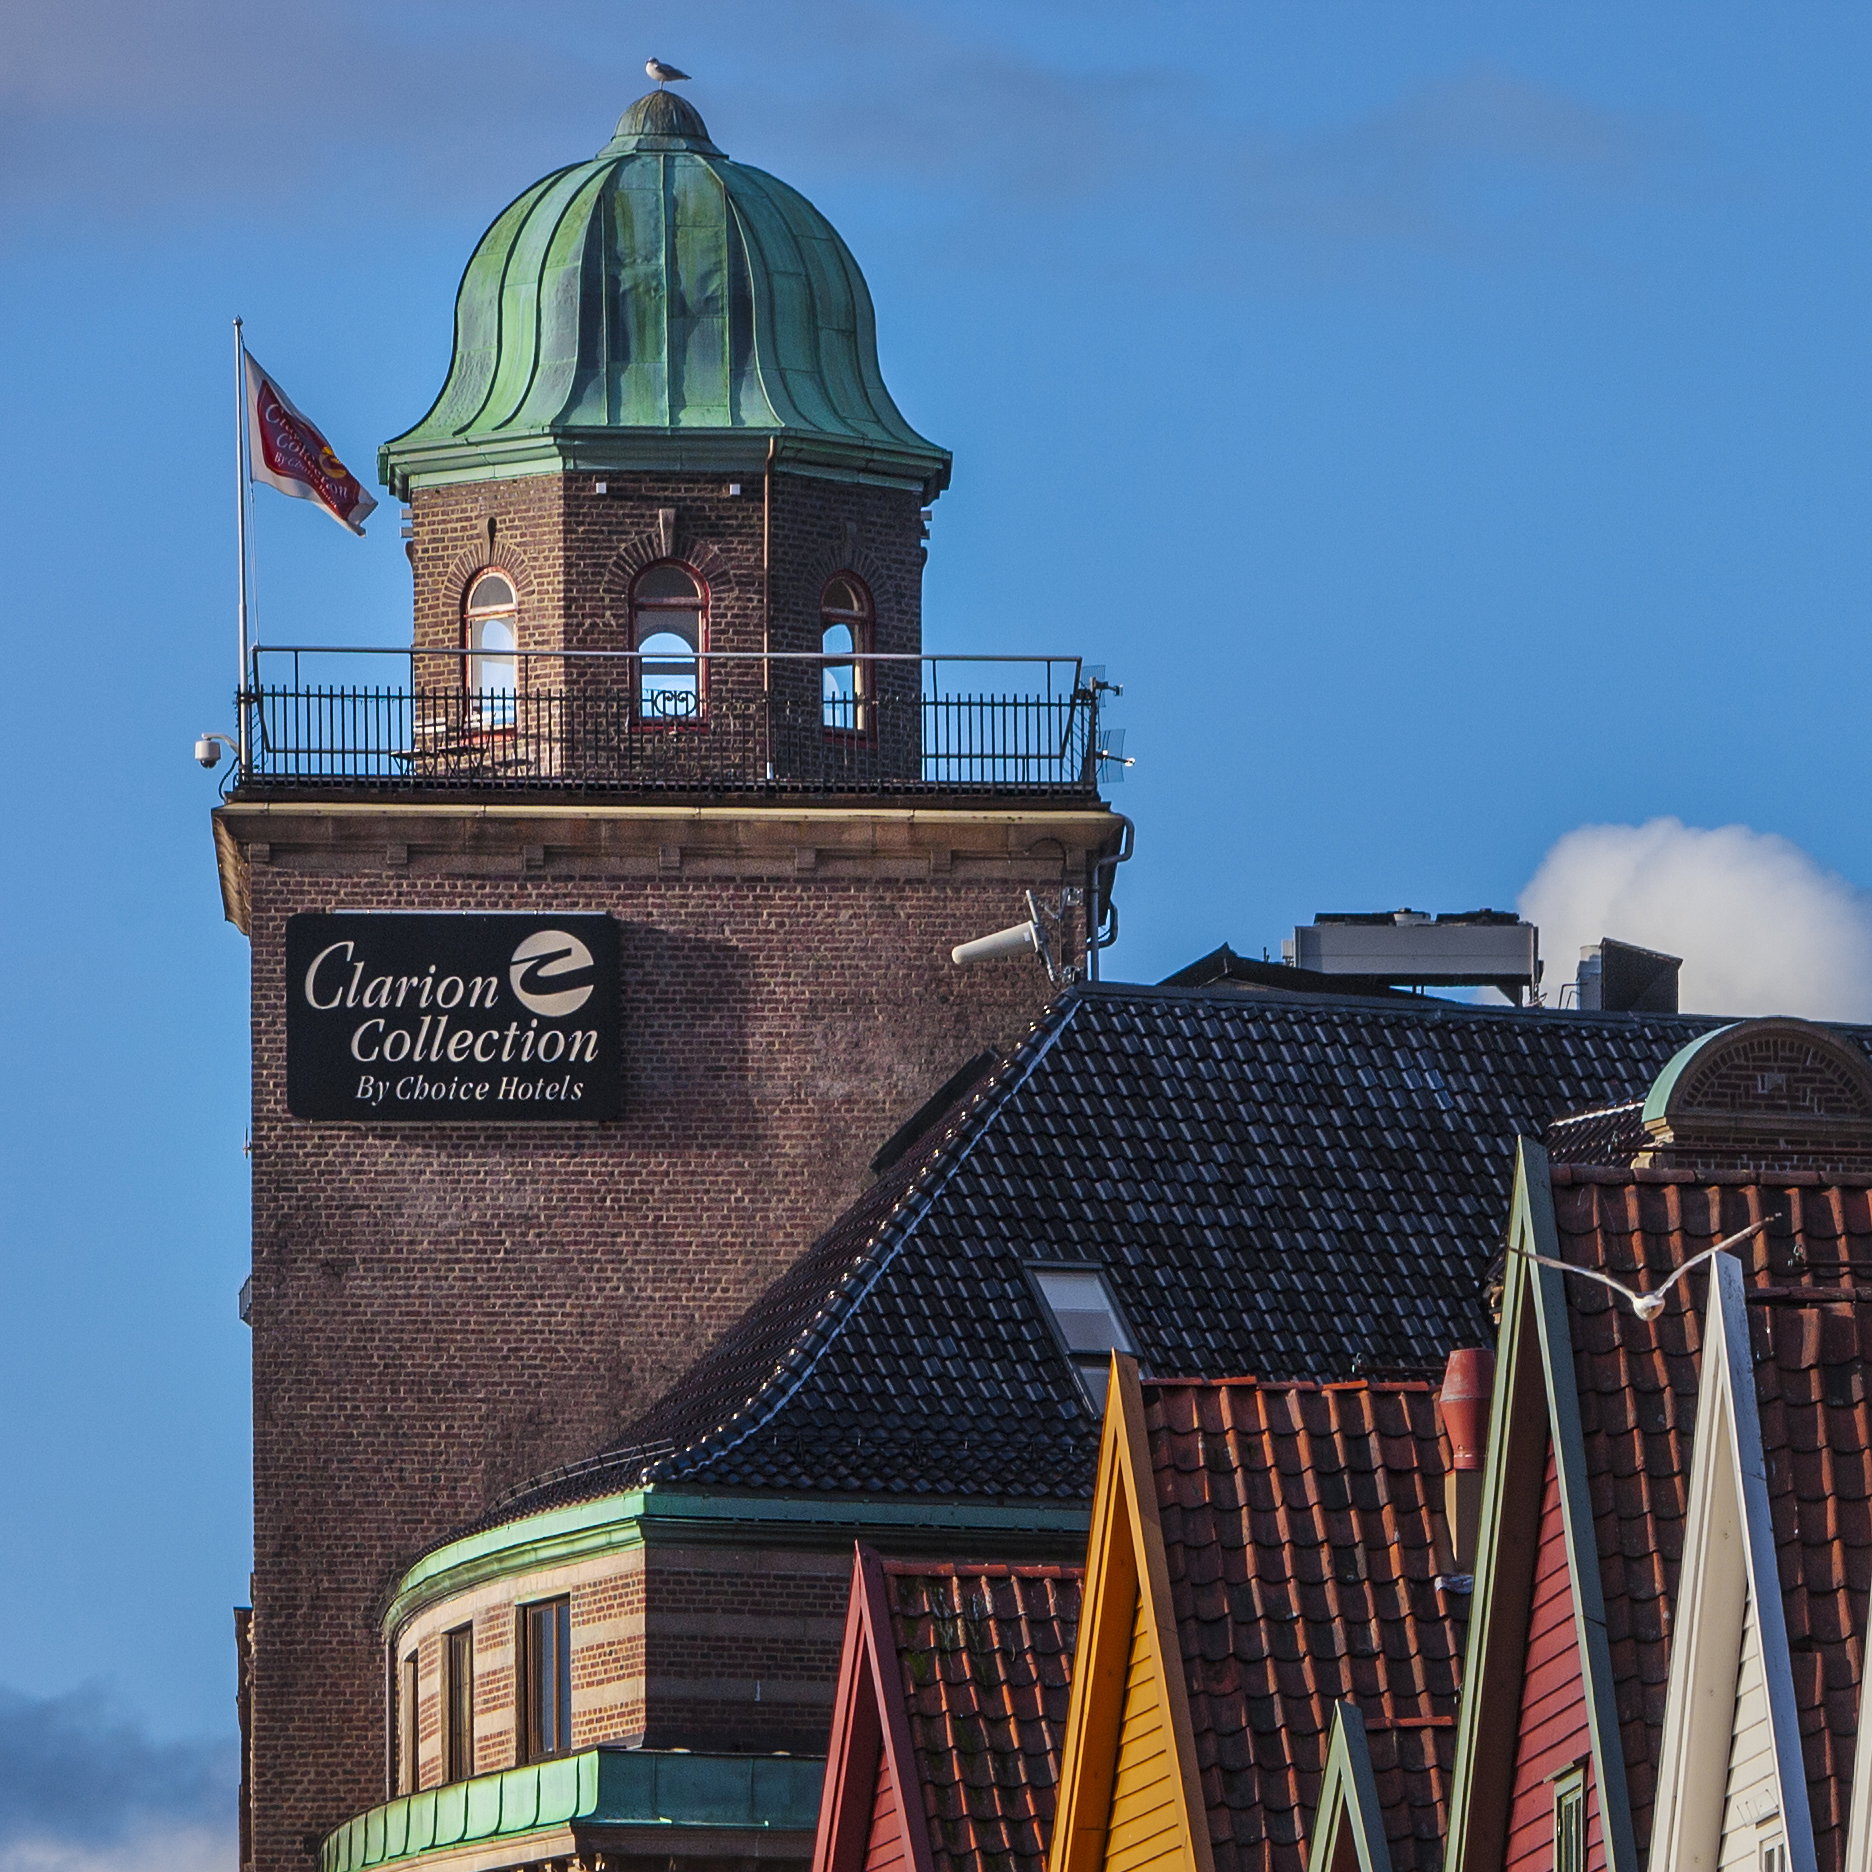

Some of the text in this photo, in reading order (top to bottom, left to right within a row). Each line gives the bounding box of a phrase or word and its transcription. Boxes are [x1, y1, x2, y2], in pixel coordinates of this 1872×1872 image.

[304, 940, 499, 1010] Clarion
[350, 1014, 599, 1063] Collection
[355, 1073, 585, 1107] By Choice Hotels
